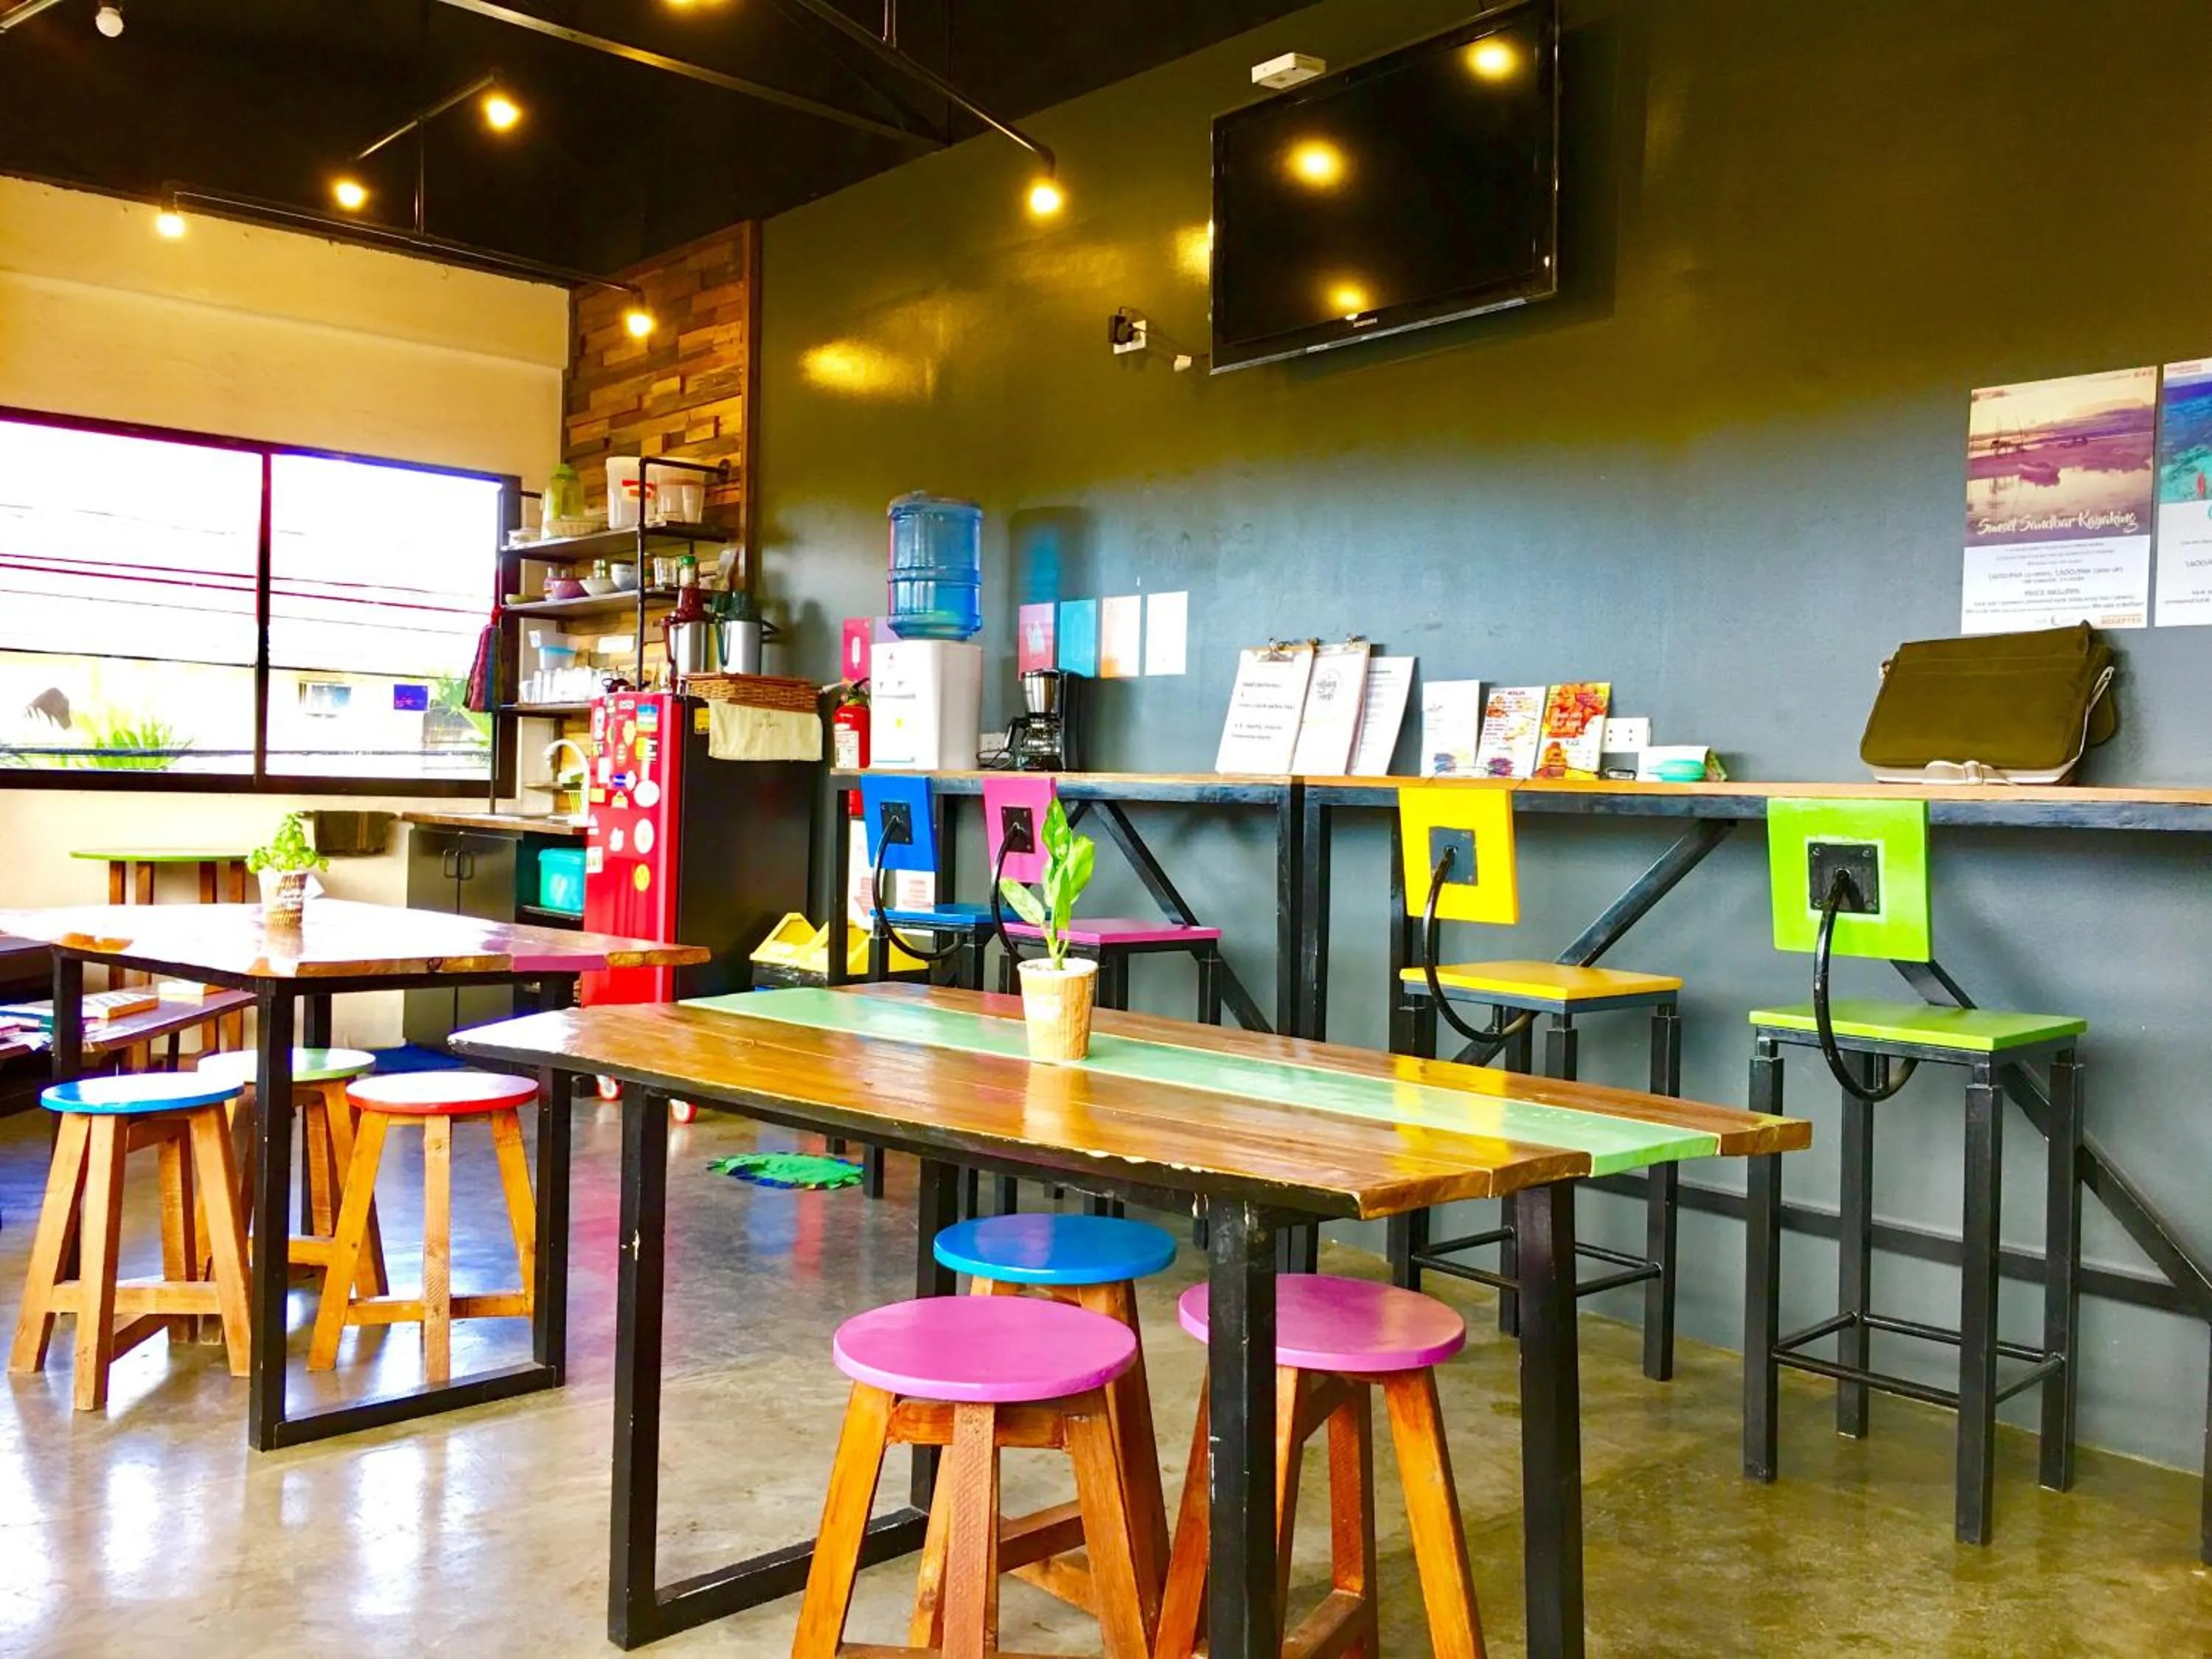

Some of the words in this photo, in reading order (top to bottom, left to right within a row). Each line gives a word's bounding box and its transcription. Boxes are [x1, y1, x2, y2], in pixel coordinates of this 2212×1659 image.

[1977, 516, 2017, 535] Sunset
[2020, 514, 2076, 532] Sandbar
[2078, 509, 2139, 534] Kayaking
